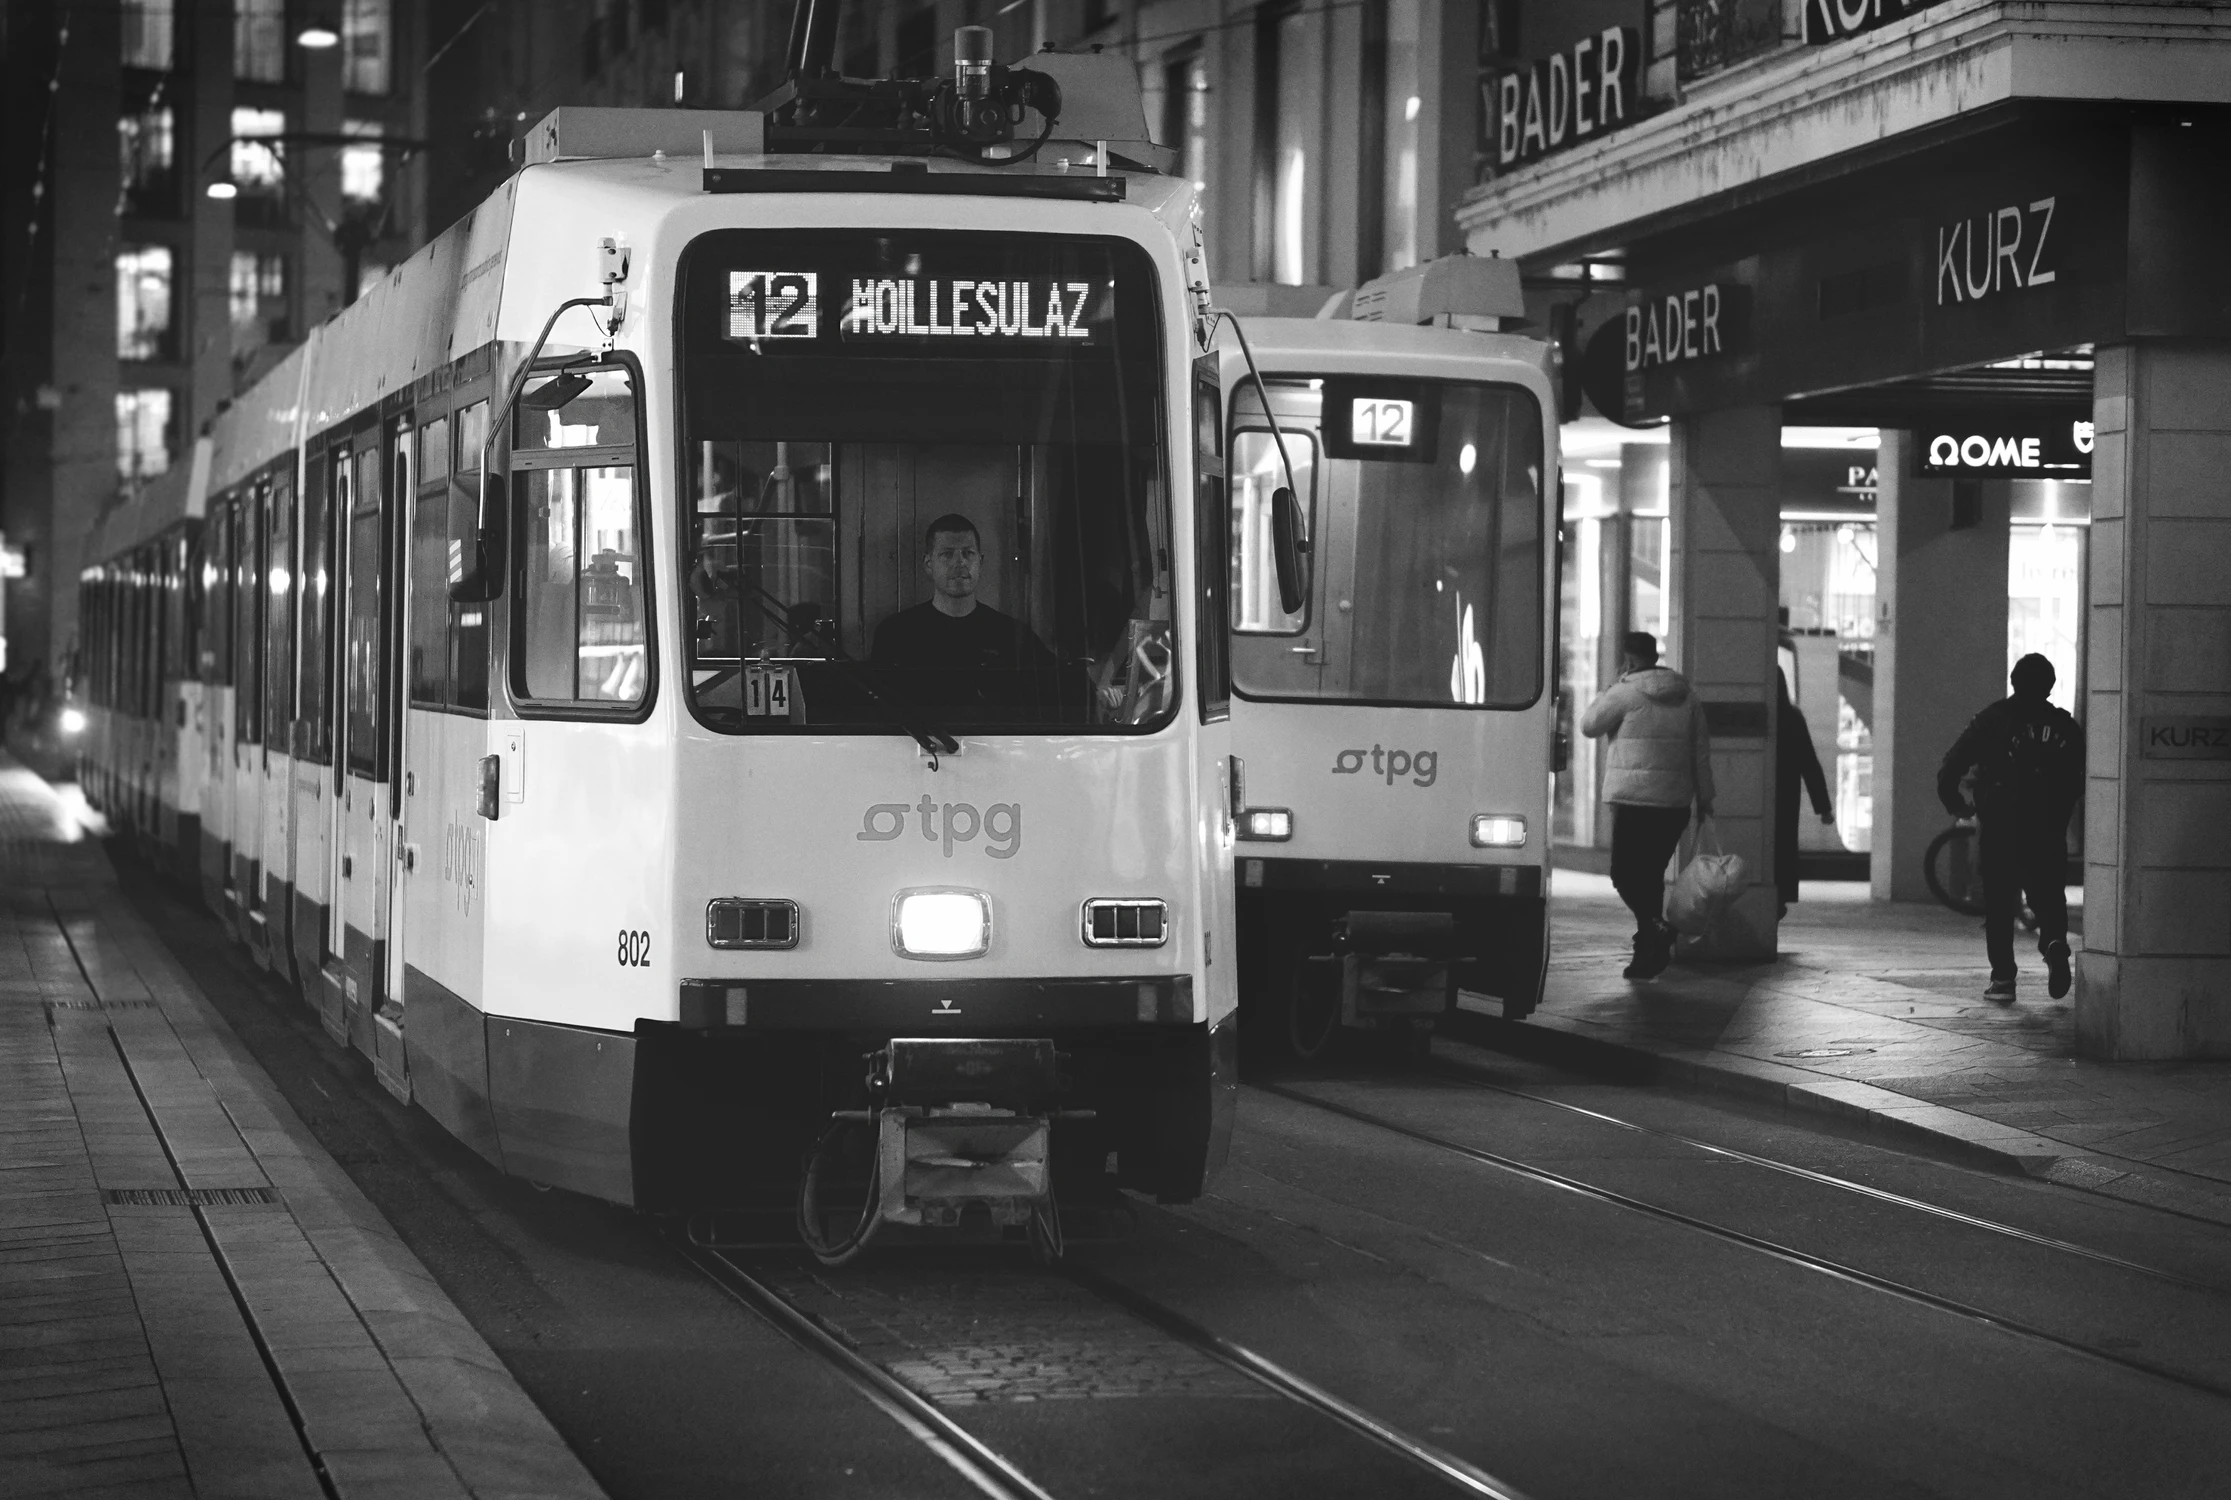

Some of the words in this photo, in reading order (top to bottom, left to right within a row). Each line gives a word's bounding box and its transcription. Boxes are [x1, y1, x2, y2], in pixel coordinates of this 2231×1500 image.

[1500, 26, 1625, 164] BADER
[1938, 197, 2056, 305] KURZ
[737, 274, 810, 336] 12
[853, 279, 1089, 337] MOILLESULAZ
[1626, 284, 1721, 371] BADER
[1361, 403, 1405, 442] 12
[750, 679, 786, 707] 14
[2151, 727, 2229, 746] KURZ
[617, 931, 650, 967] 802
